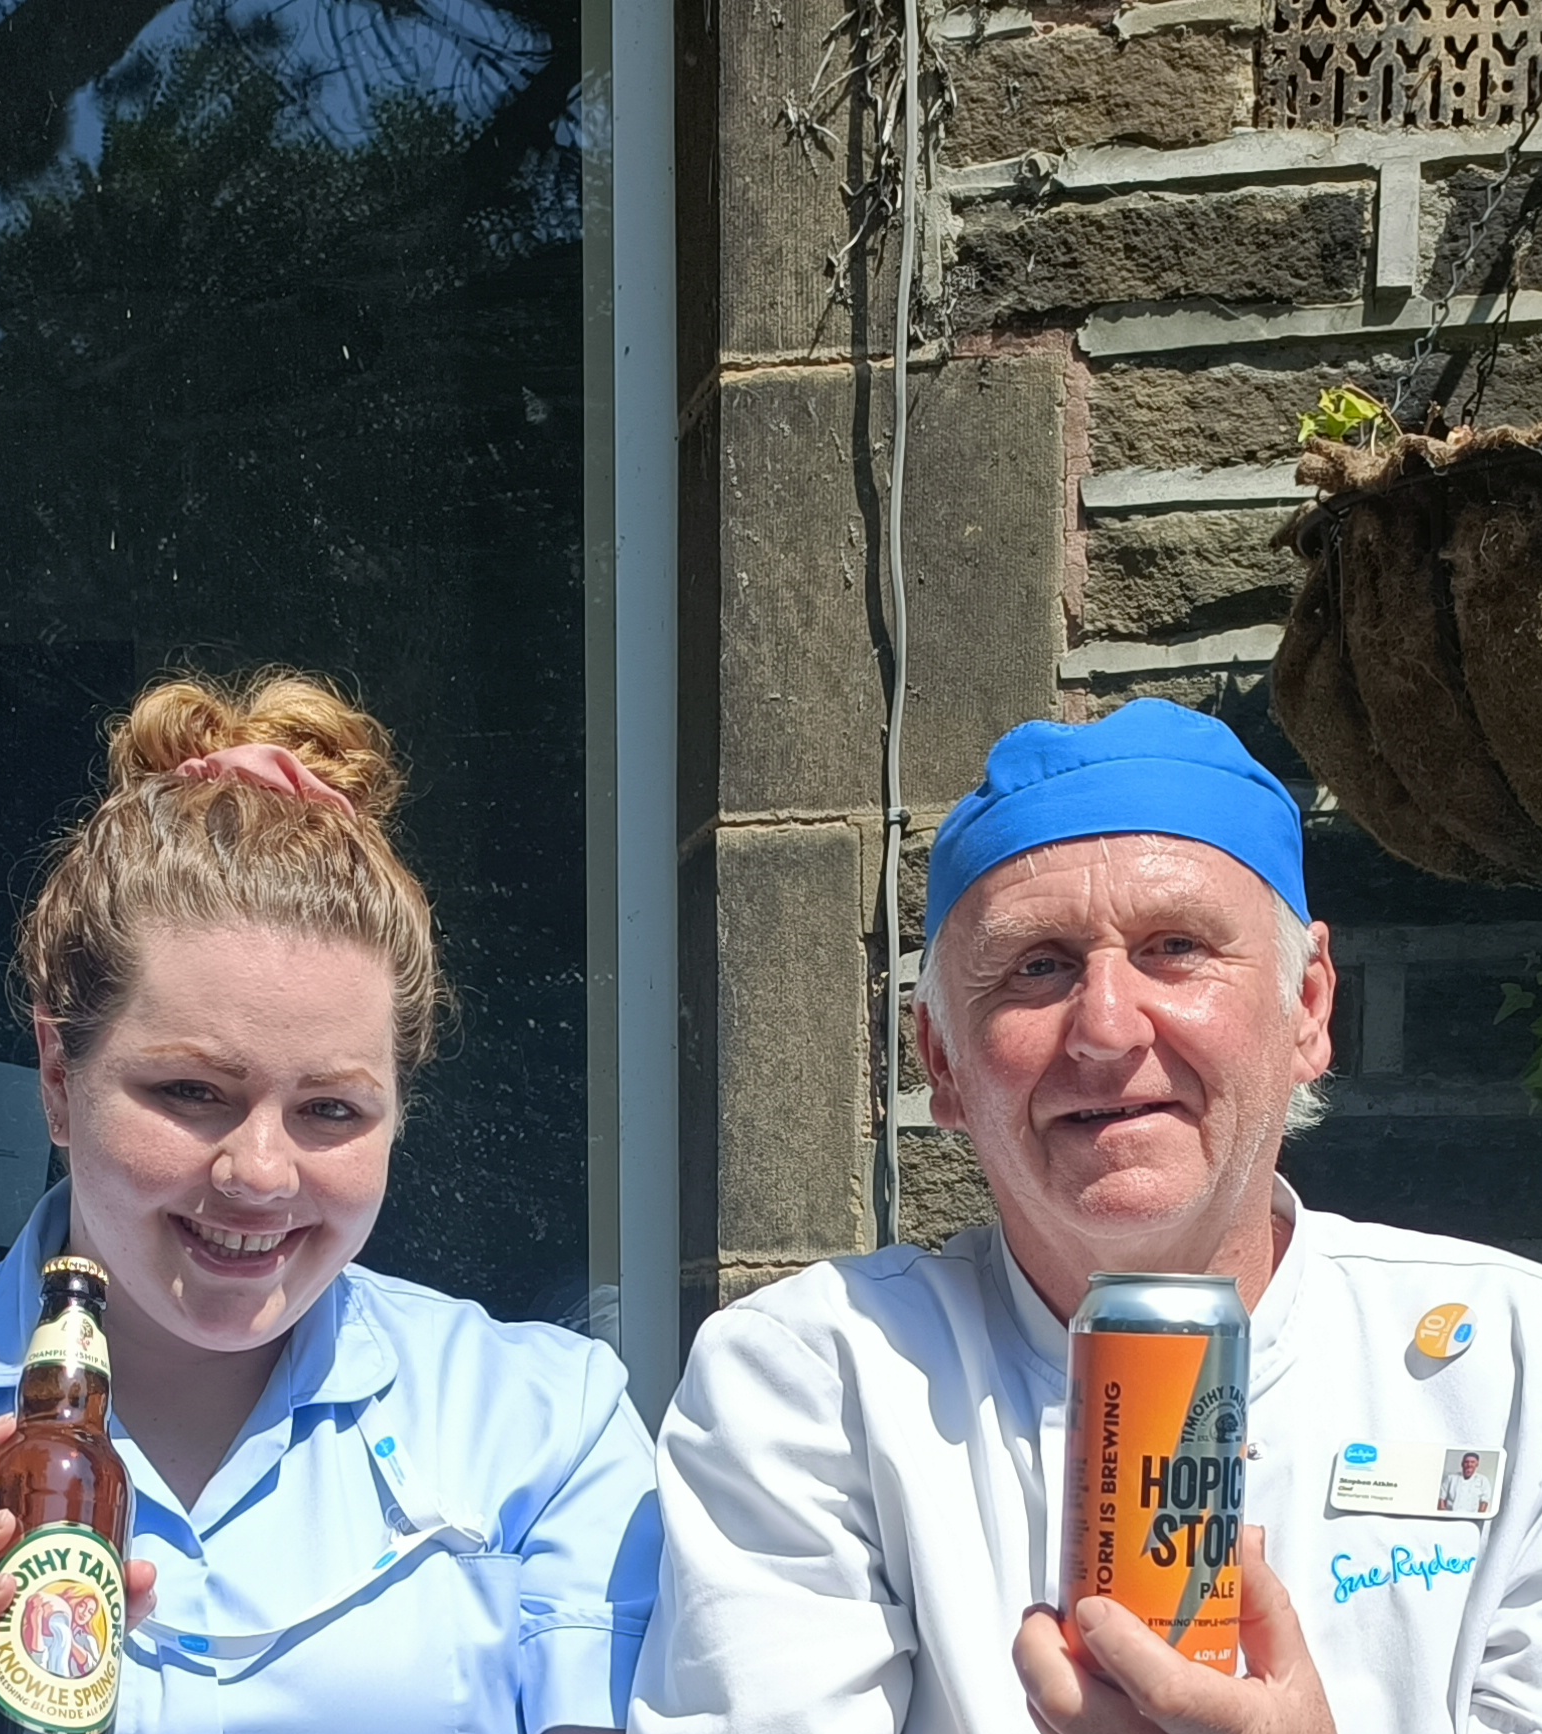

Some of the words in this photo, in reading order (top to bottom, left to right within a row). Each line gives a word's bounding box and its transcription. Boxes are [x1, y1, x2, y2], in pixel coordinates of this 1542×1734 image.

[1101, 1381, 1121, 1494] BREWING
[1181, 1386, 1225, 1444] TIMOTHY
[1141, 1455, 1243, 1510] HOPIC
[1100, 1502, 1116, 1523] IS
[1096, 1530, 1115, 1596] TORM
[1150, 1513, 1239, 1568] STOR
[1200, 1581, 1234, 1600] PALE
[1331, 1553, 1392, 1604] Sue
[1390, 1543, 1477, 1592] Ryder
[30, 1700, 85, 1720] BLONDE
[73, 1660, 116, 1708] SPRING
